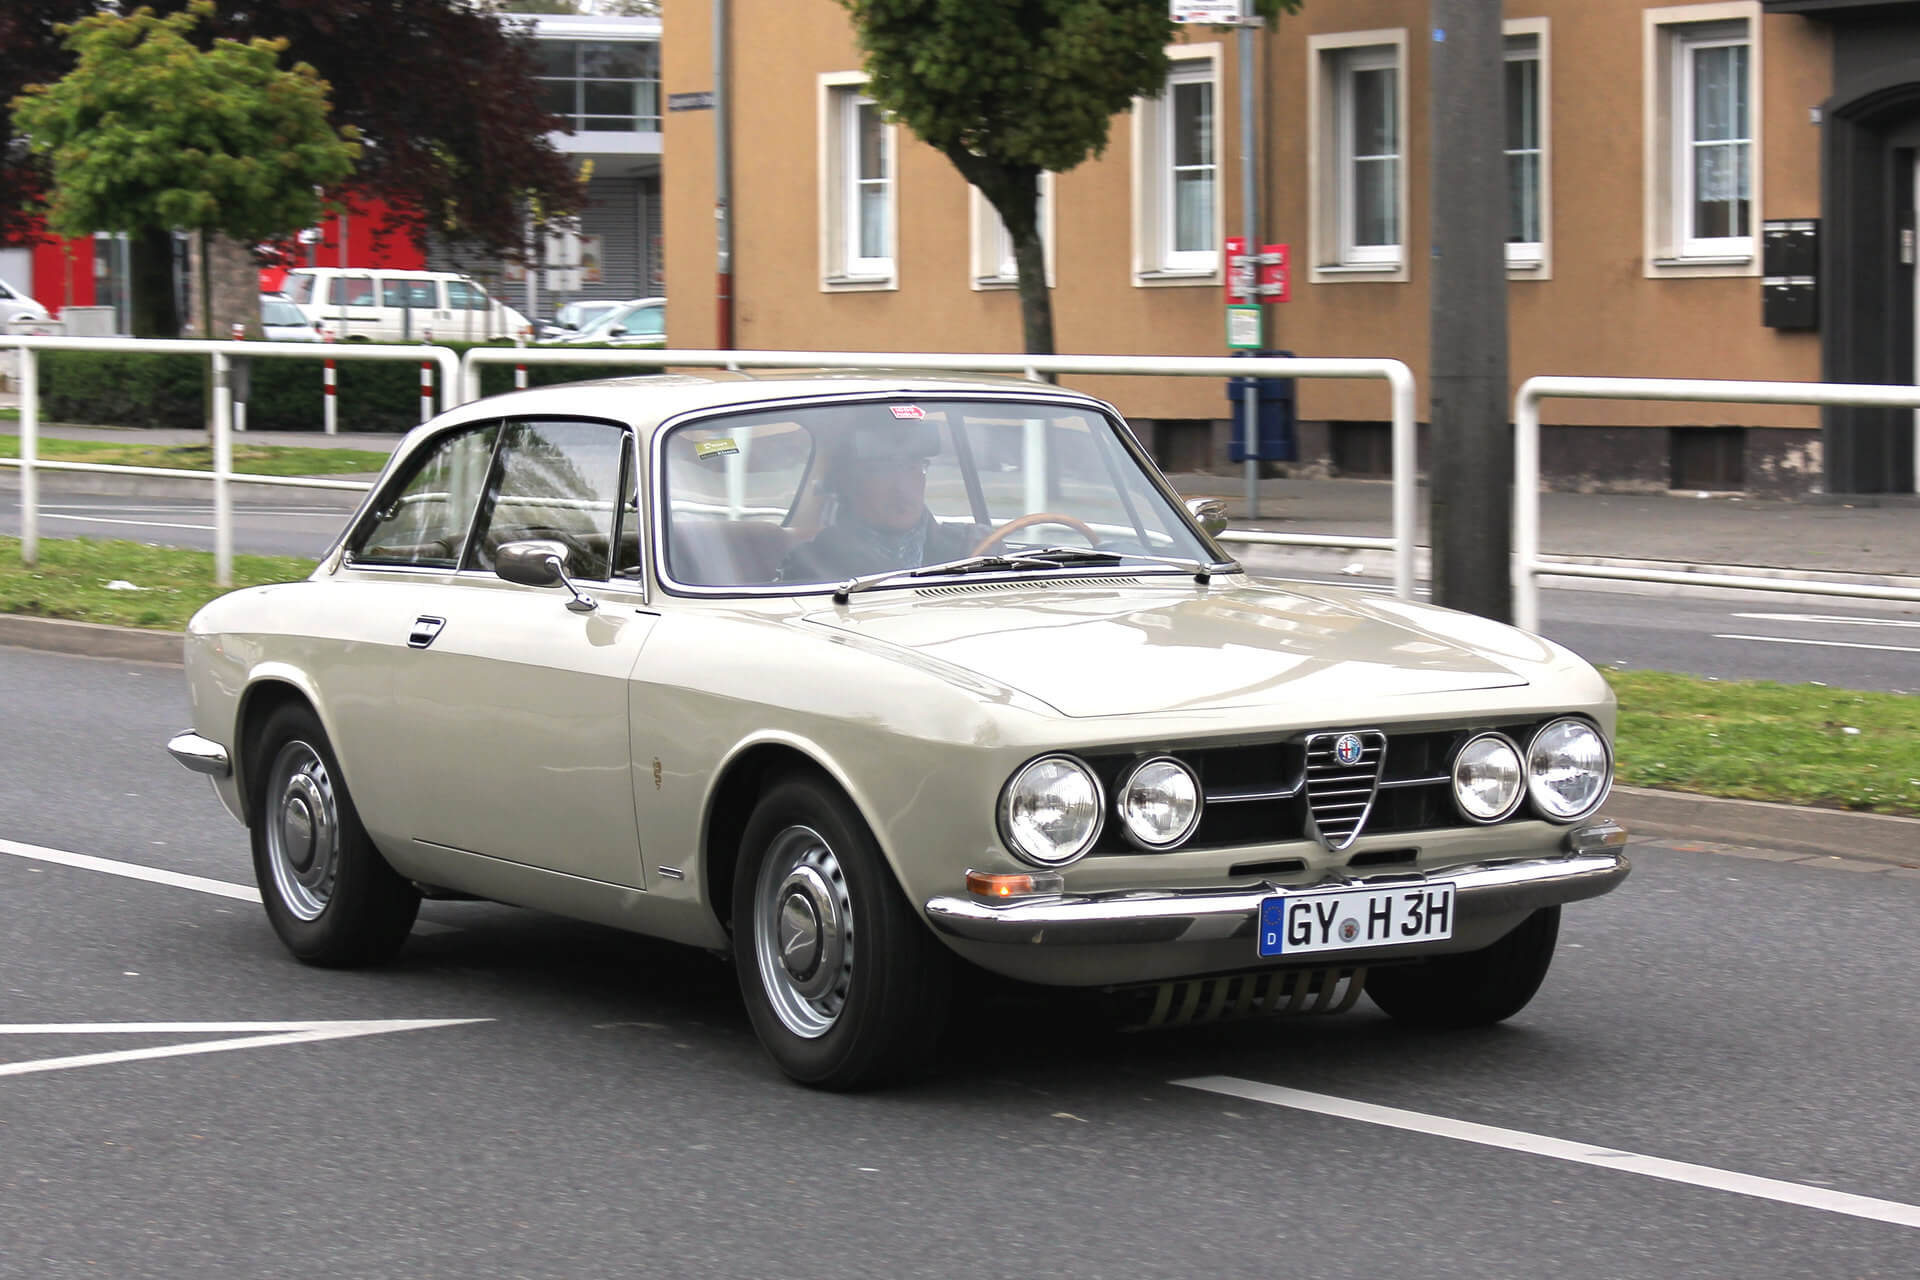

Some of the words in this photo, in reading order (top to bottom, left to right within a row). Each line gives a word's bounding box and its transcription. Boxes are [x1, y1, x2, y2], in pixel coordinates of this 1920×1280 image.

[1288, 901, 1339, 946] GY
[1368, 897, 1392, 940] H
[1401, 891, 1449, 936] 3H
[1267, 933, 1276, 945] D
